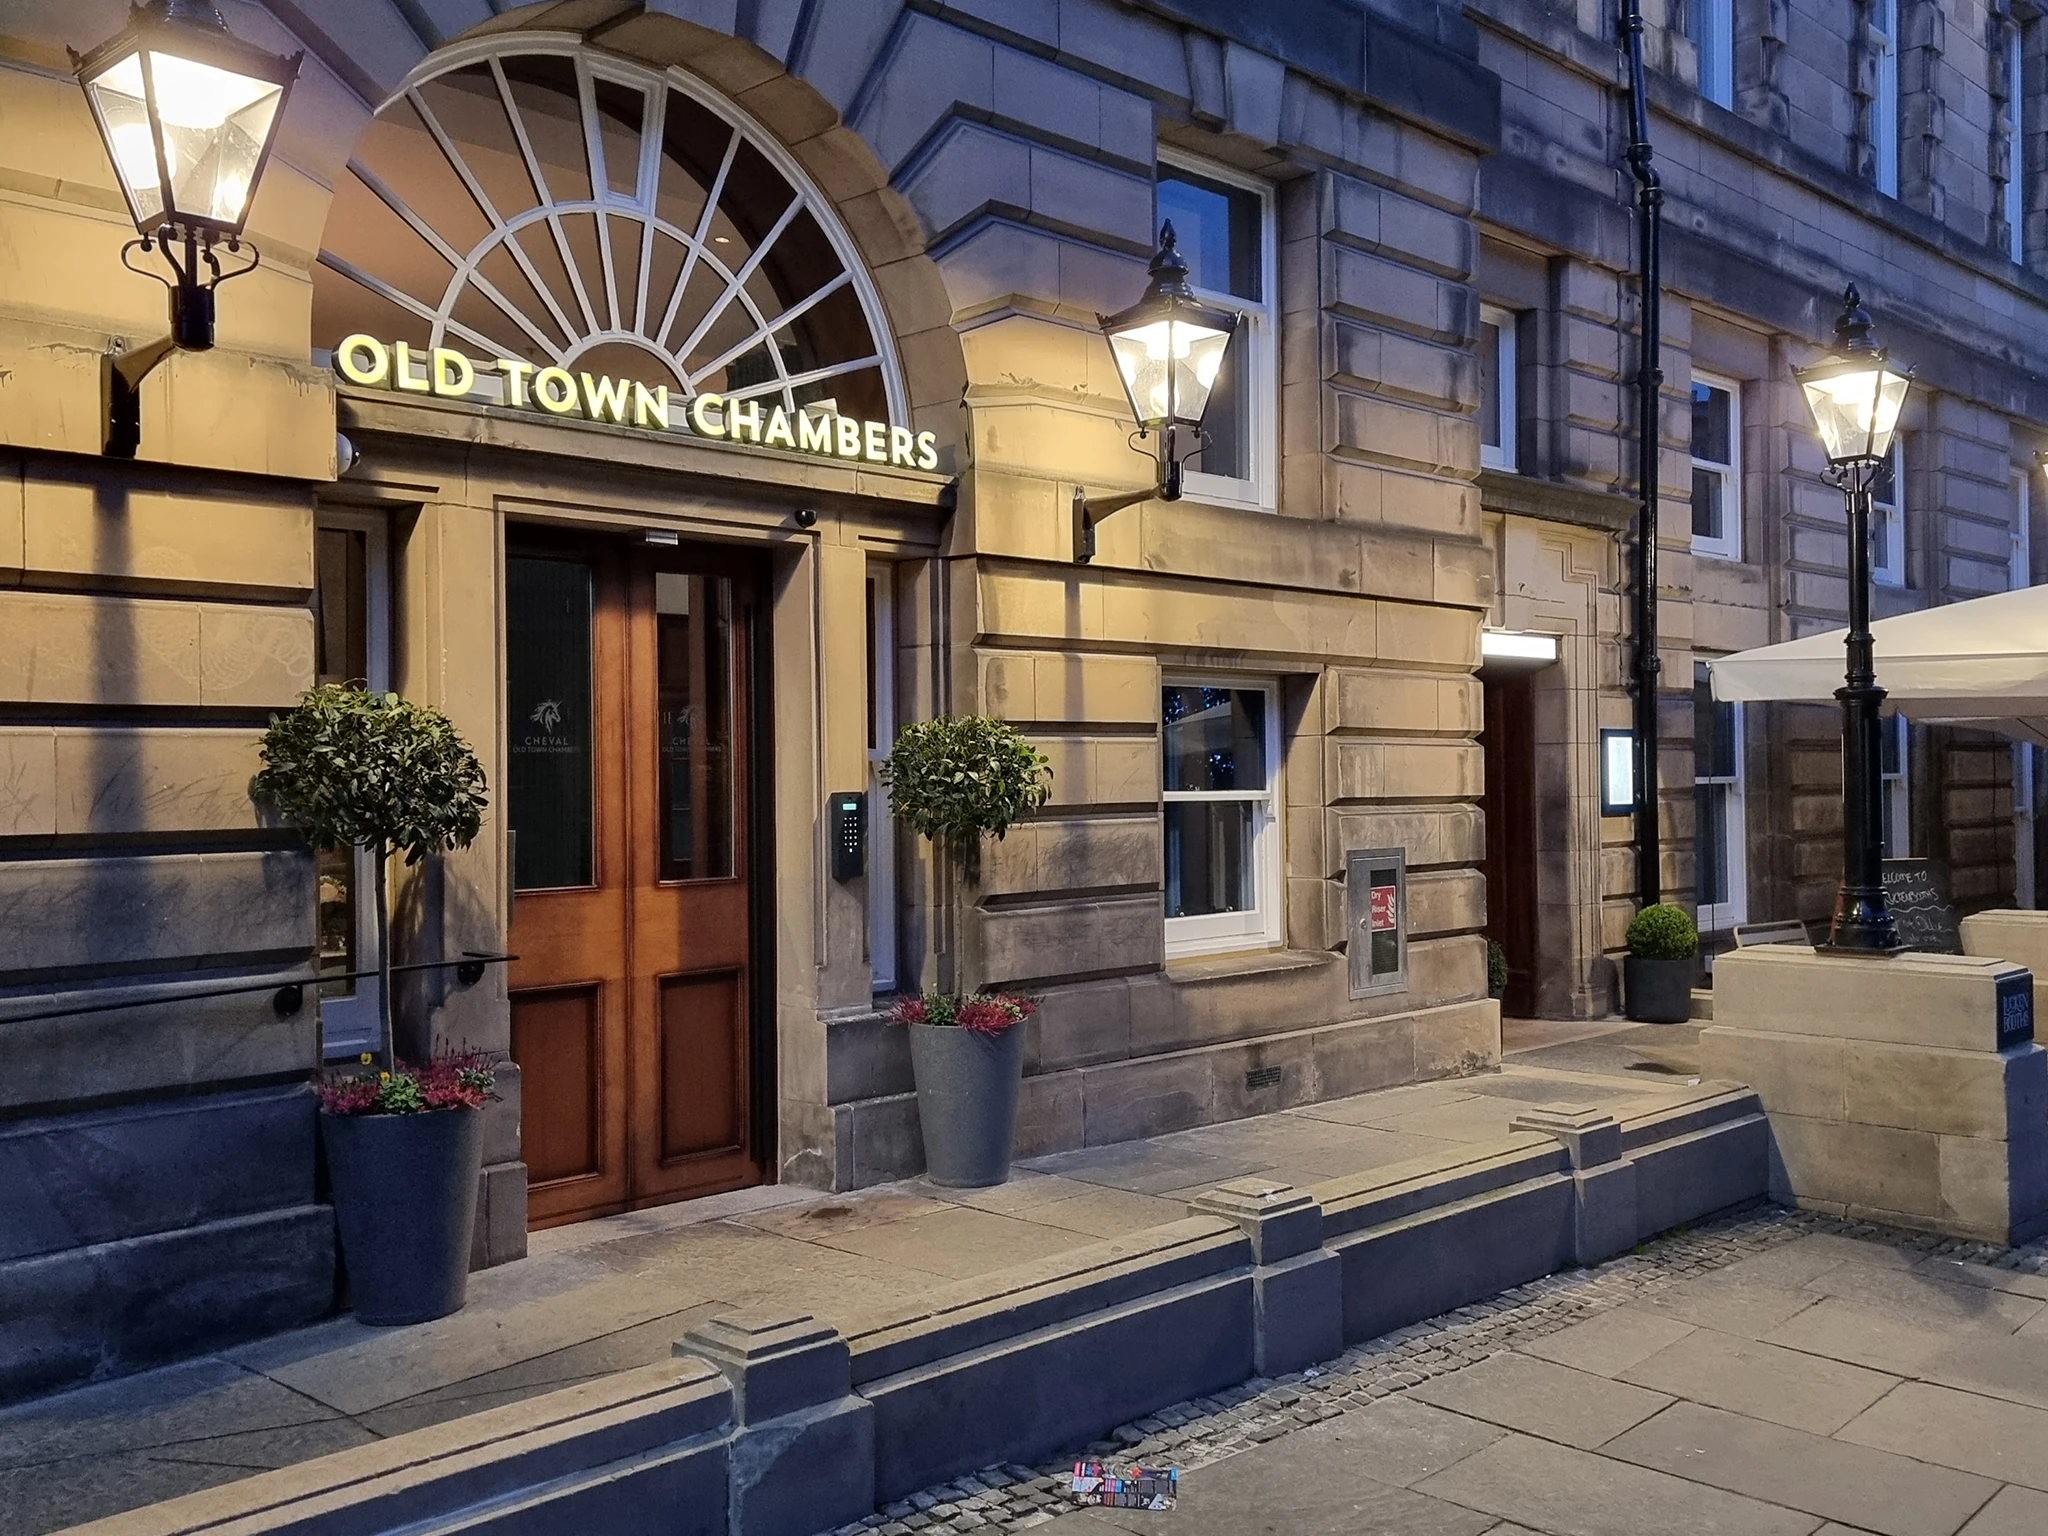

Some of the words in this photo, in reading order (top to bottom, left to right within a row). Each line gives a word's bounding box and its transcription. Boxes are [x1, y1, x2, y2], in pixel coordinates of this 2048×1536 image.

[333, 333, 474, 396] OLD
[496, 358, 670, 429] TOWN
[687, 392, 939, 470] CHAMBERS
[524, 736, 569, 746] CHEVAL
[1881, 871, 1913, 884] ELCOME
[1914, 870, 1927, 882] TO
[1371, 891, 1381, 900] Dry
[1371, 905, 1386, 913] Riser
[1371, 919, 1384, 927] Inlet
[2003, 1011, 2030, 1033] BOOTHS
